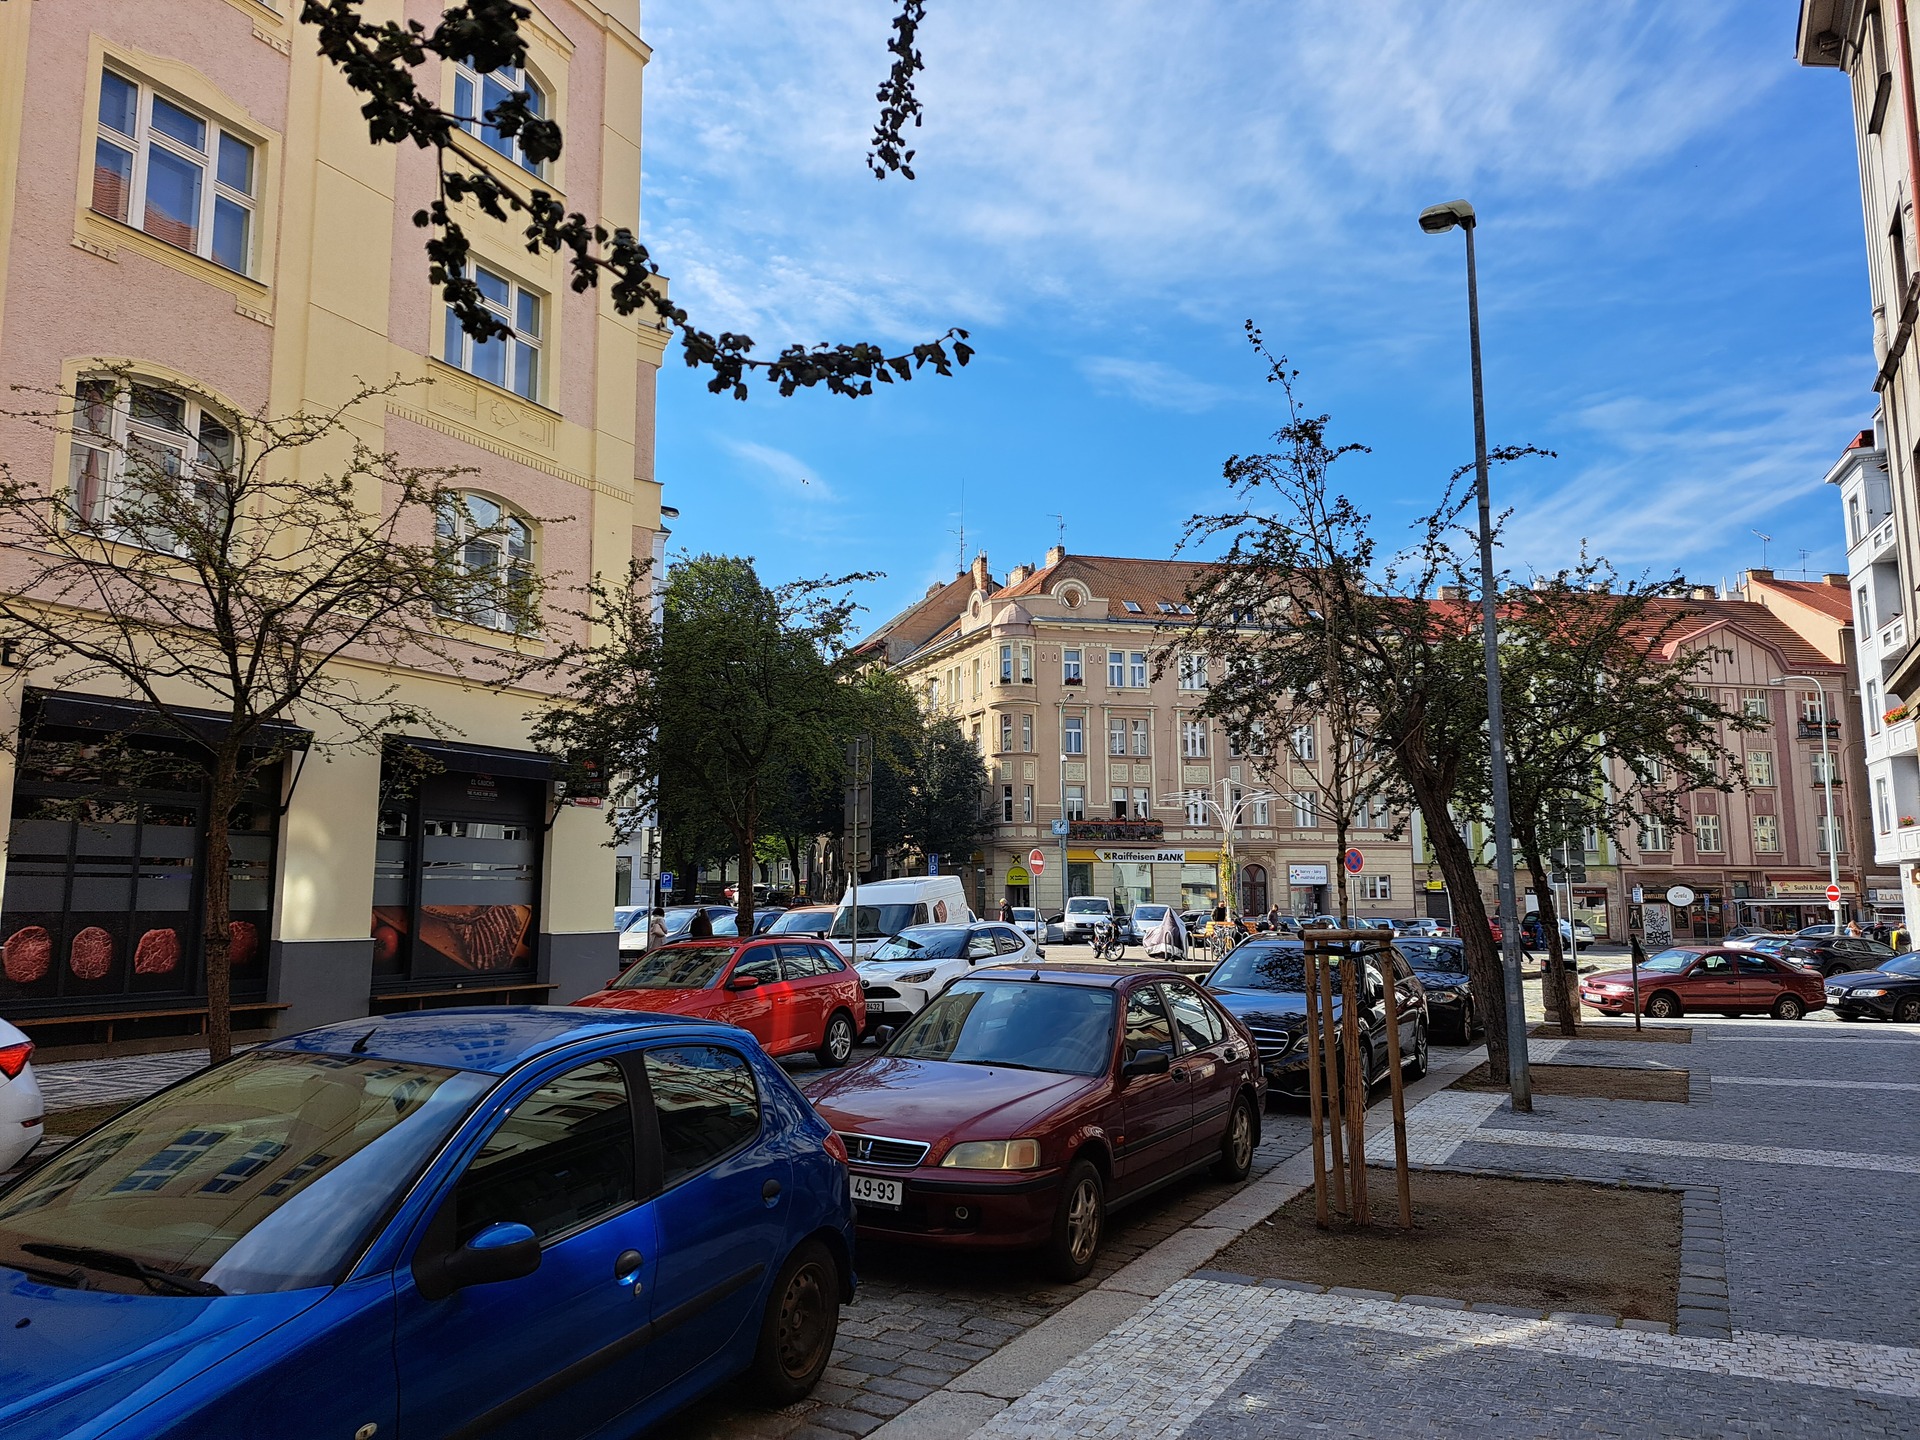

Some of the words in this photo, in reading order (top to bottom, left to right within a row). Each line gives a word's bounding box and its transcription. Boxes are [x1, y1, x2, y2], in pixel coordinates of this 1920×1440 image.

[1112, 852, 1155, 861] Raiffeisen
[1157, 853, 1183, 861] BANK
[663, 874, 670, 884] P
[854, 1178, 895, 1201] 49-93
